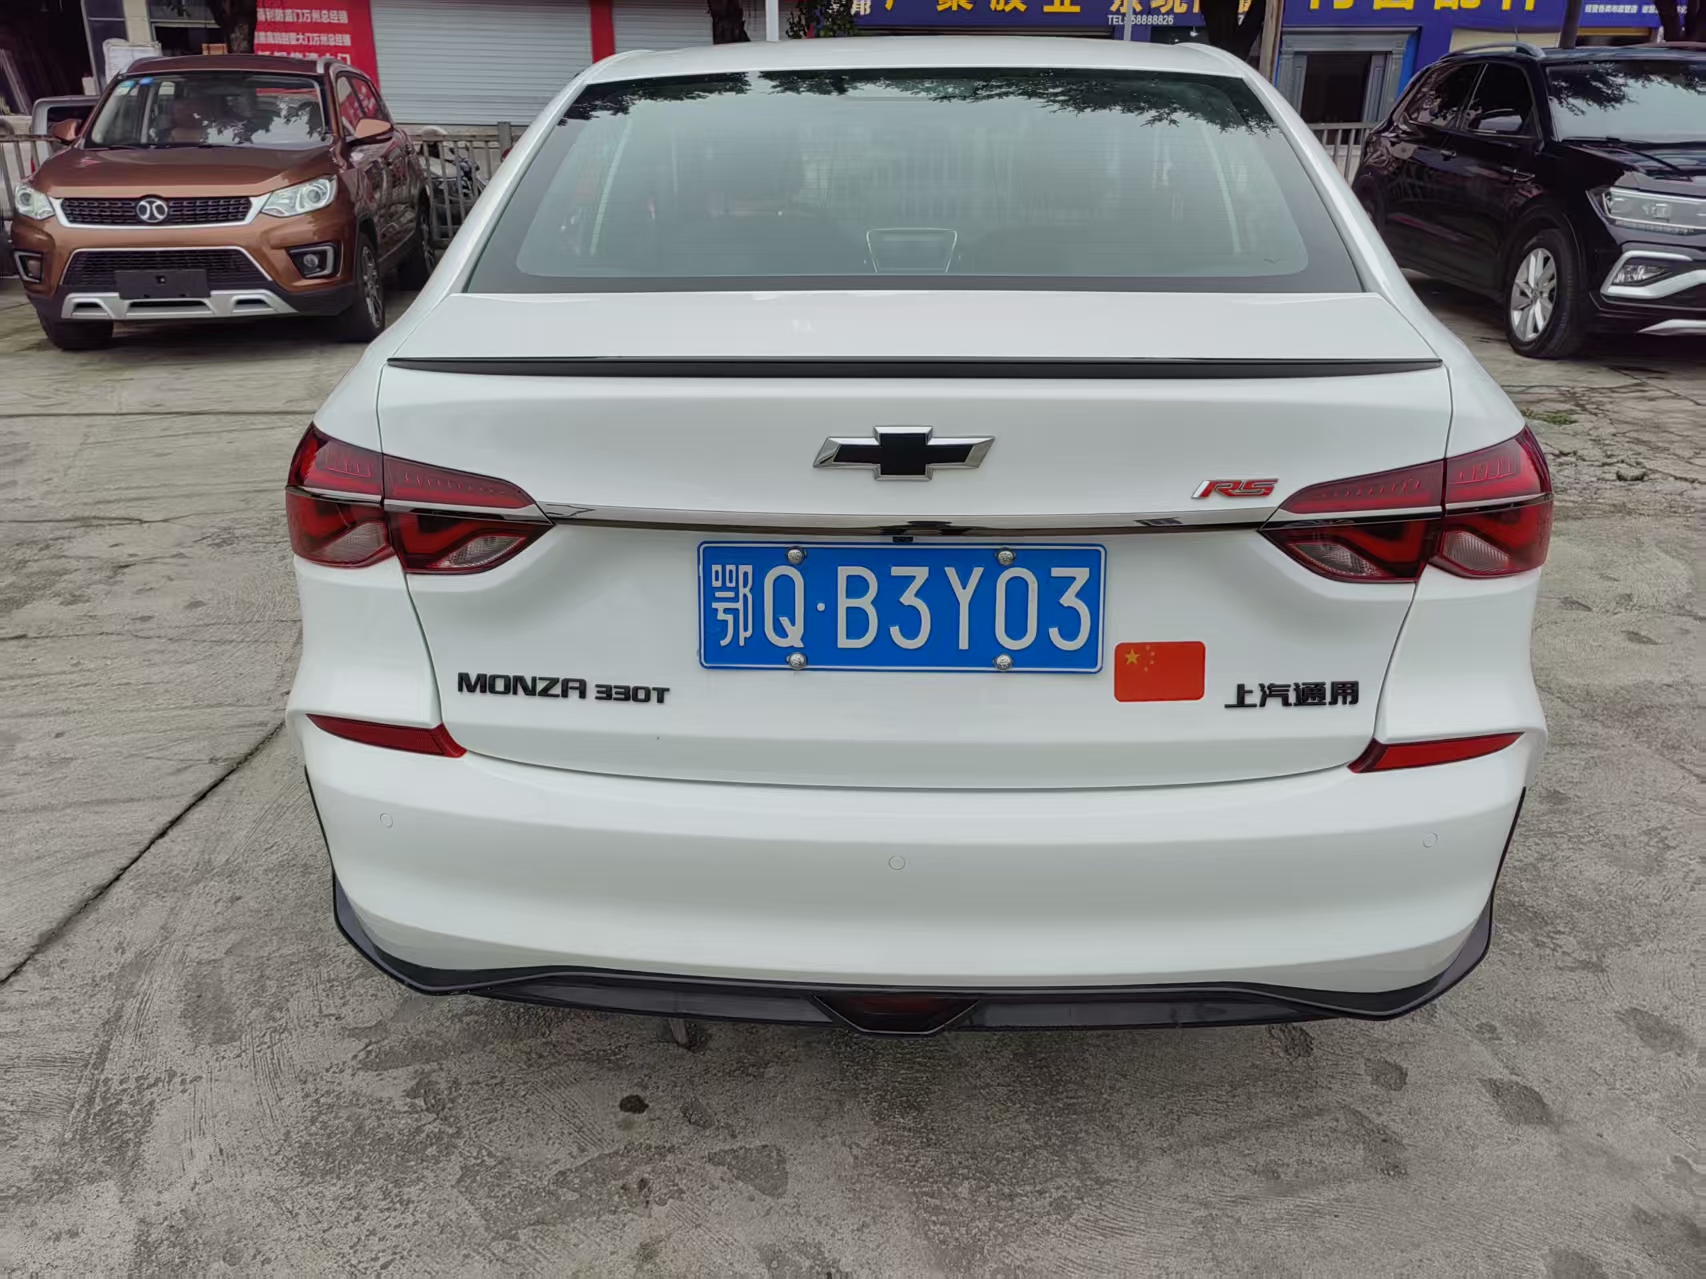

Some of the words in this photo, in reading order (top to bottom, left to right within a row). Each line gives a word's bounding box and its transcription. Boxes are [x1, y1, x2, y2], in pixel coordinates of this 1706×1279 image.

[1191, 478, 1279, 499] RS
[458, 672, 587, 699] MONZA
[595, 684, 670, 703] 330T
[1224, 681, 1359, 708] 上汽通用
